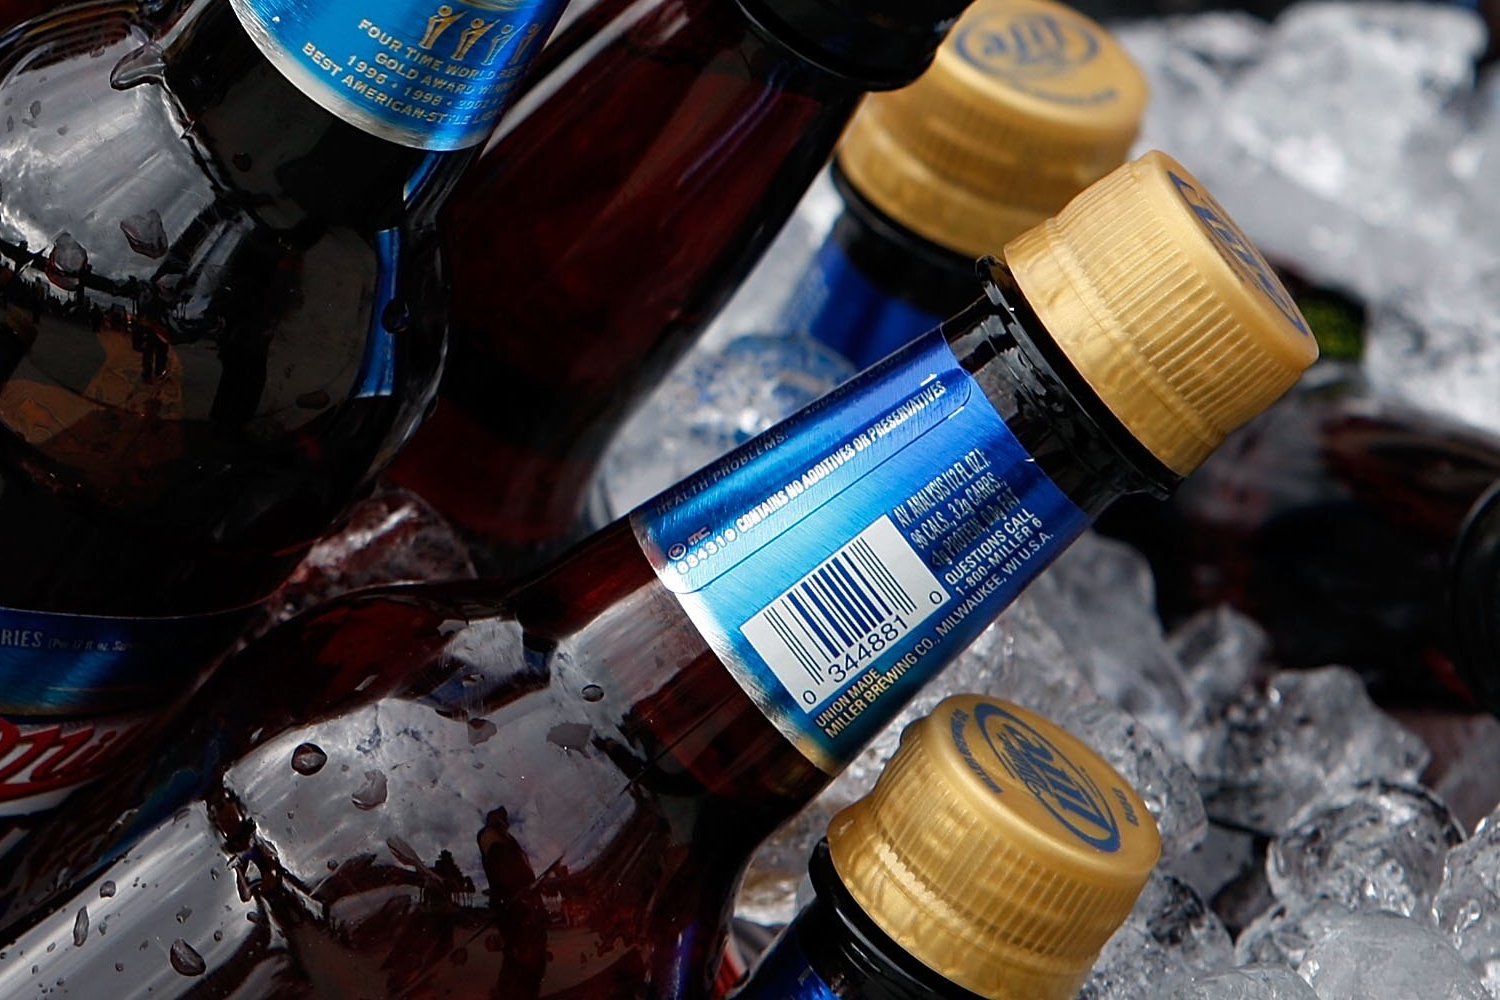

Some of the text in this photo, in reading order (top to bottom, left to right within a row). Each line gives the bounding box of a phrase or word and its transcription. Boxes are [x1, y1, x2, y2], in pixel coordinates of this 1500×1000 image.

[357, 17, 402, 52] FOUR
[406, 46, 440, 73] TIME
[446, 63, 497, 82] WORLD
[375, 51, 417, 82] GOLD
[420, 72, 476, 96] AWARD
[303, 41, 469, 127] BEST AMERICAN-STYLE
[347, 53, 389, 88] 1996
[403, 85, 442, 109] 1998
[712, 432, 790, 483] PROBLEMS.
[736, 490, 789, 533] CONTAINS
[802, 443, 856, 490] ADDITIVES
[854, 431, 871, 451] OR
[868, 380, 947, 443] PRESERVATIVES
[893, 503, 915, 530] AV.
[905, 470, 951, 518] ANALYSIS
[910, 530, 926, 549] 96
[919, 511, 957, 541] CALS.,
[942, 514, 990, 555] PROTEIN,
[944, 507, 1035, 585] QUESTIONS CALL
[955, 516, 1042, 597] 1-800-MILLER 6
[929, 590, 943, 606] 0
[824, 699, 868, 740] MILLER
[863, 652, 918, 705] BREWING
[914, 636, 941, 656] CO.,
[935, 573, 1008, 638] MILWAUKEE,
[1020, 531, 1055, 561] U.S.A.
[827, 615, 908, 683] 344881
[802, 689, 817, 706] 0
[815, 666, 881, 728] UNION MADE
[1002, 722, 1112, 832] Lite
